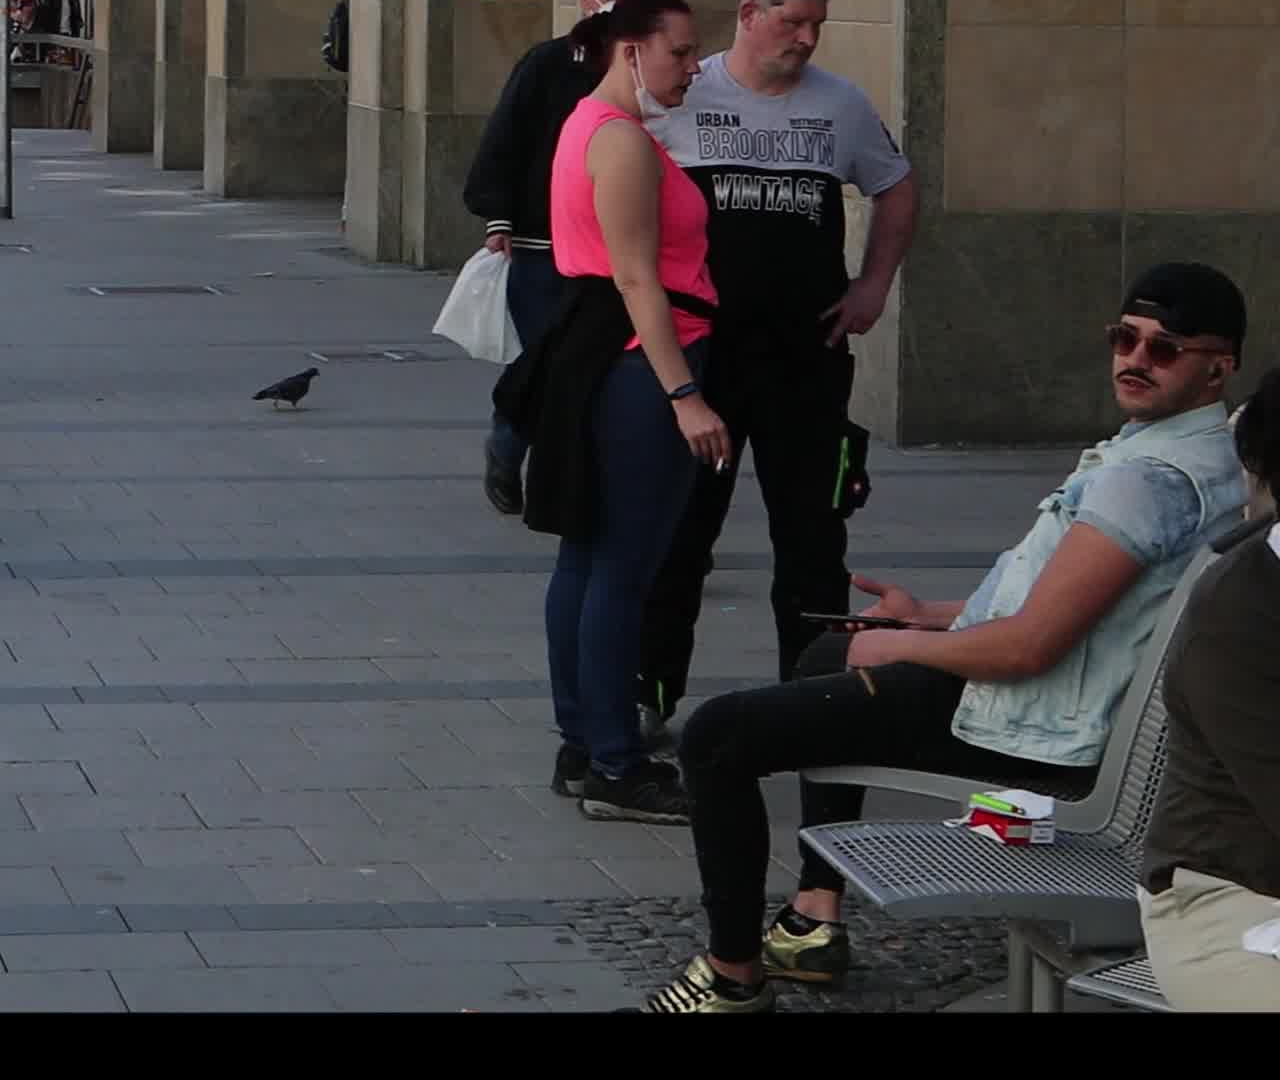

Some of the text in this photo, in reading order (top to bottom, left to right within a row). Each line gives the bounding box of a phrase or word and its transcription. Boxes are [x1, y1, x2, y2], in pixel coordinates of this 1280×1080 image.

[695, 112, 741, 128] URBAN
[696, 127, 836, 167] BROOKLYN
[711, 173, 827, 217] VINTAGE
